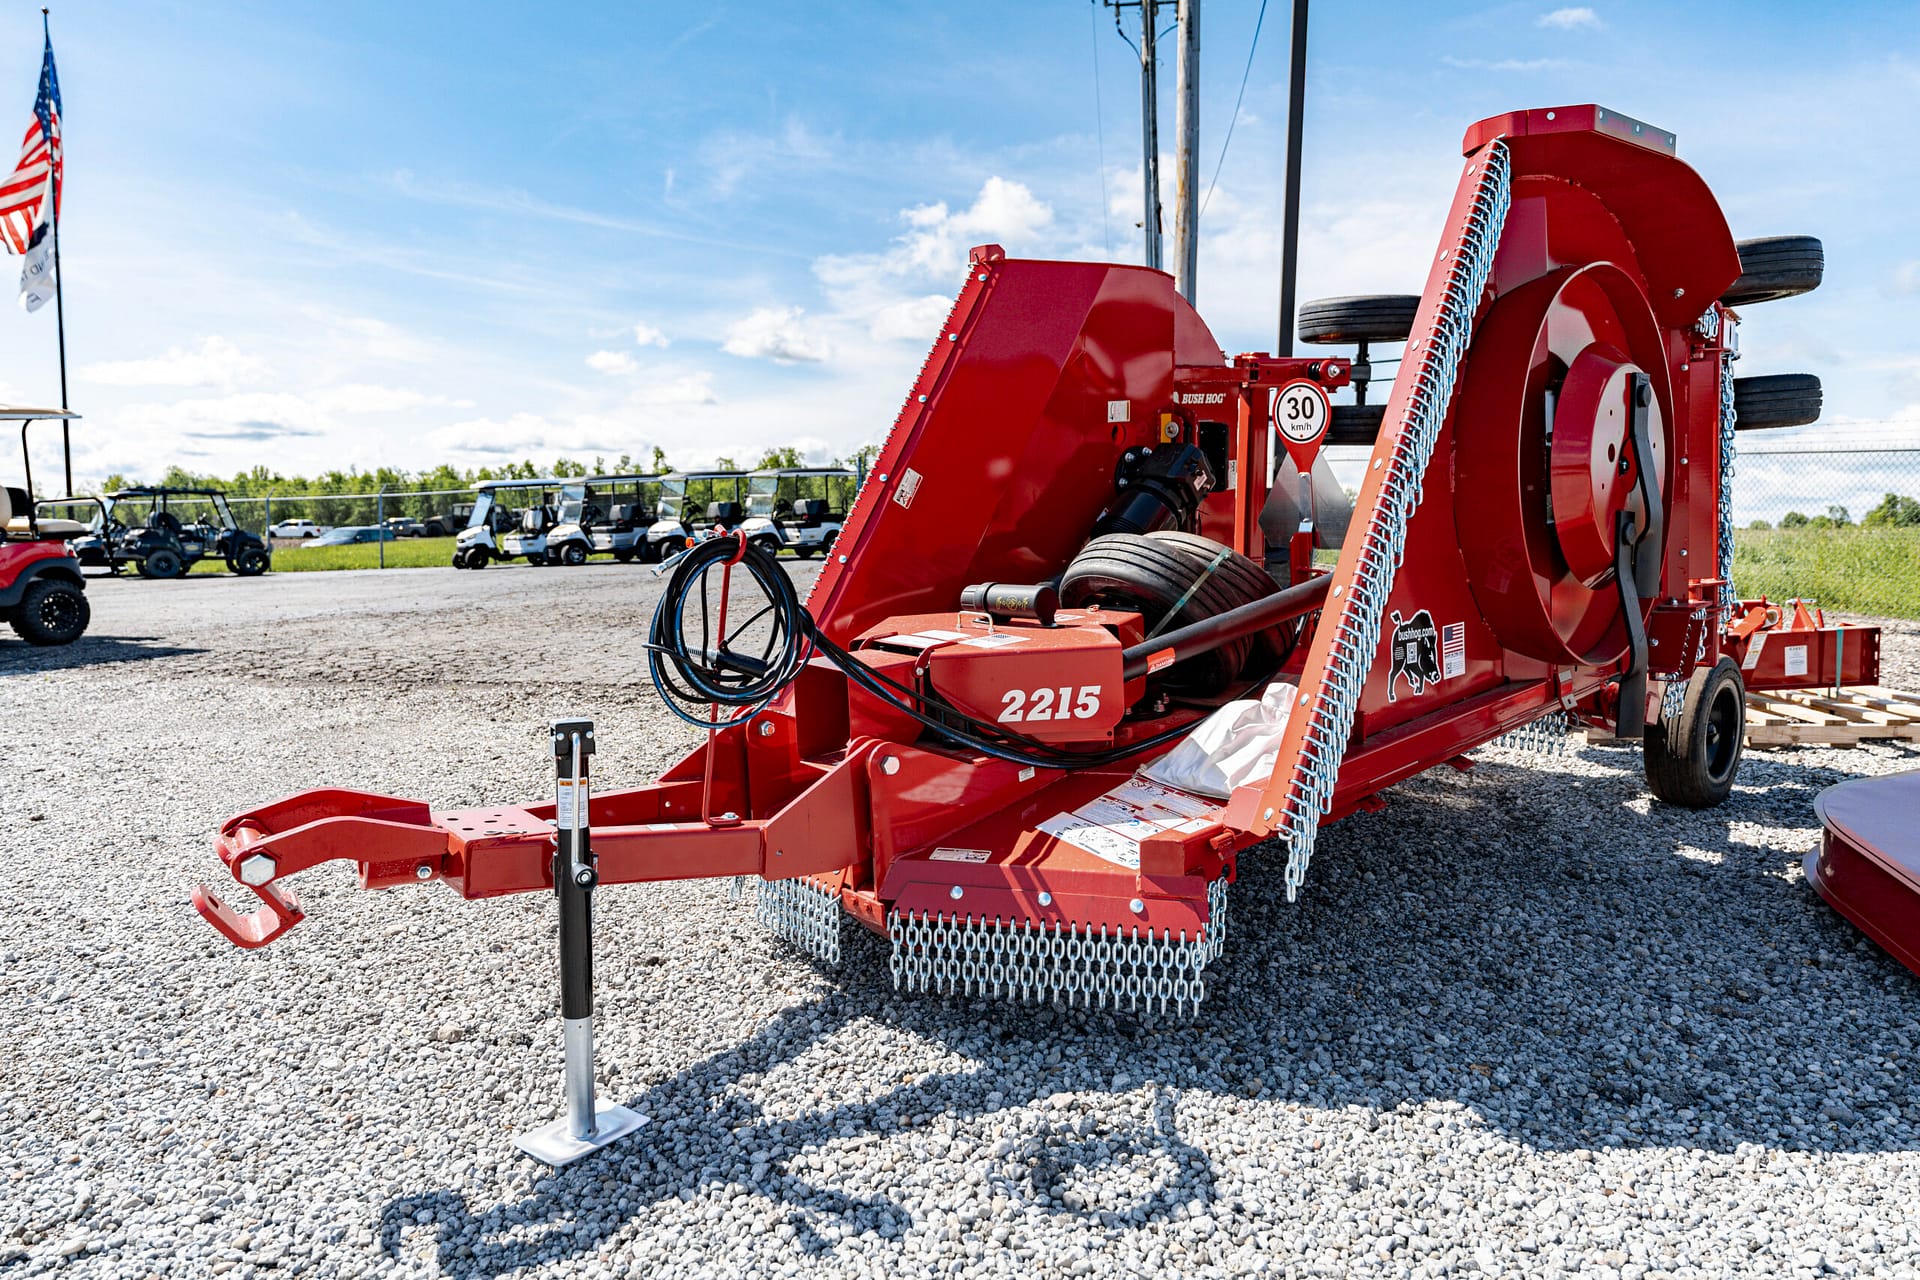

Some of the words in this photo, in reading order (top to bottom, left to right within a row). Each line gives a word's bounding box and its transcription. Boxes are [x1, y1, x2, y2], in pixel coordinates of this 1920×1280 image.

[1181, 393, 1205, 404] BUSH
[1287, 396, 1315, 420] 30
[1291, 422, 1312, 431] km/h
[1398, 627, 1434, 641] bushhog.com
[997, 685, 1102, 723] 2215
